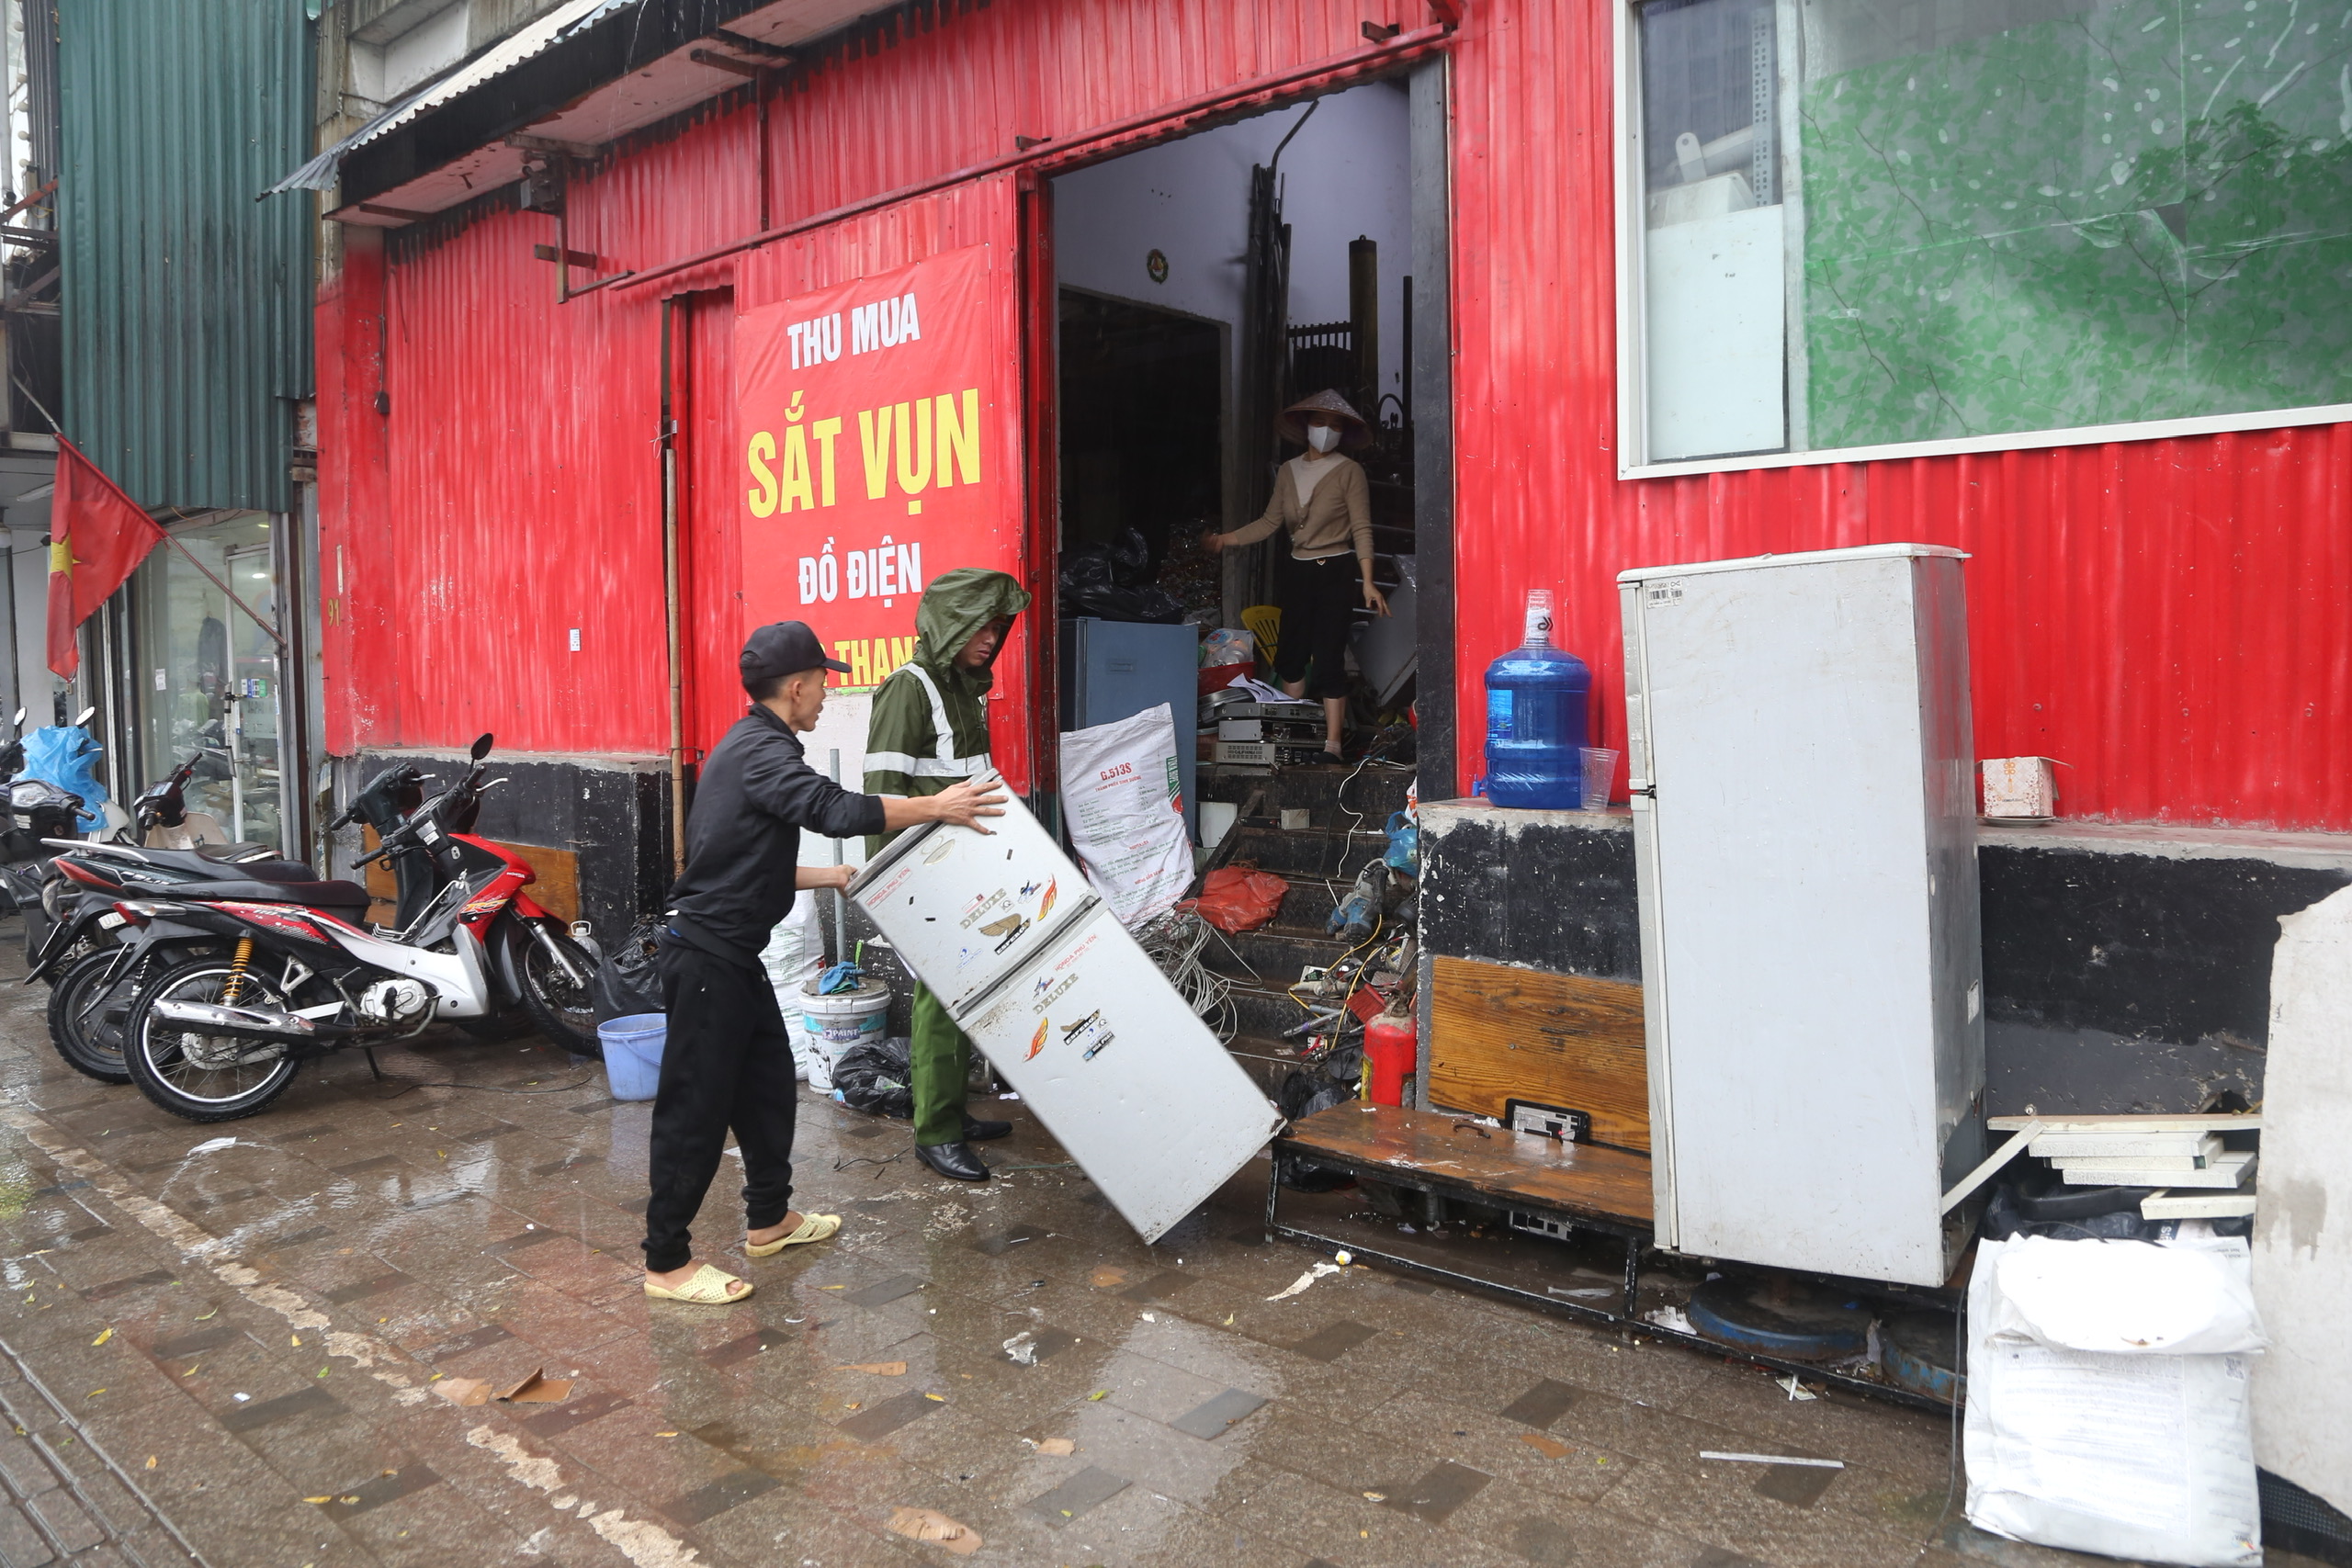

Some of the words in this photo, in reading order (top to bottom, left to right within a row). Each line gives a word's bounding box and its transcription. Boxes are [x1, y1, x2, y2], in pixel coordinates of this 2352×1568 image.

[787, 312, 842, 370] THU
[851, 292, 921, 355] MUA
[747, 389, 842, 518] SẮT
[857, 388, 981, 516] VỤN
[797, 536, 838, 605] ĐỒ
[846, 535, 922, 607] ĐIỆN
[327, 598, 340, 627] 91
[834, 636, 921, 686] THAN
[1100, 762, 1133, 782] G.513S
[959, 887, 1007, 930] DELUXE
[1033, 973, 1080, 1015] DELUXE
[832, 1028, 858, 1037] PAINT
